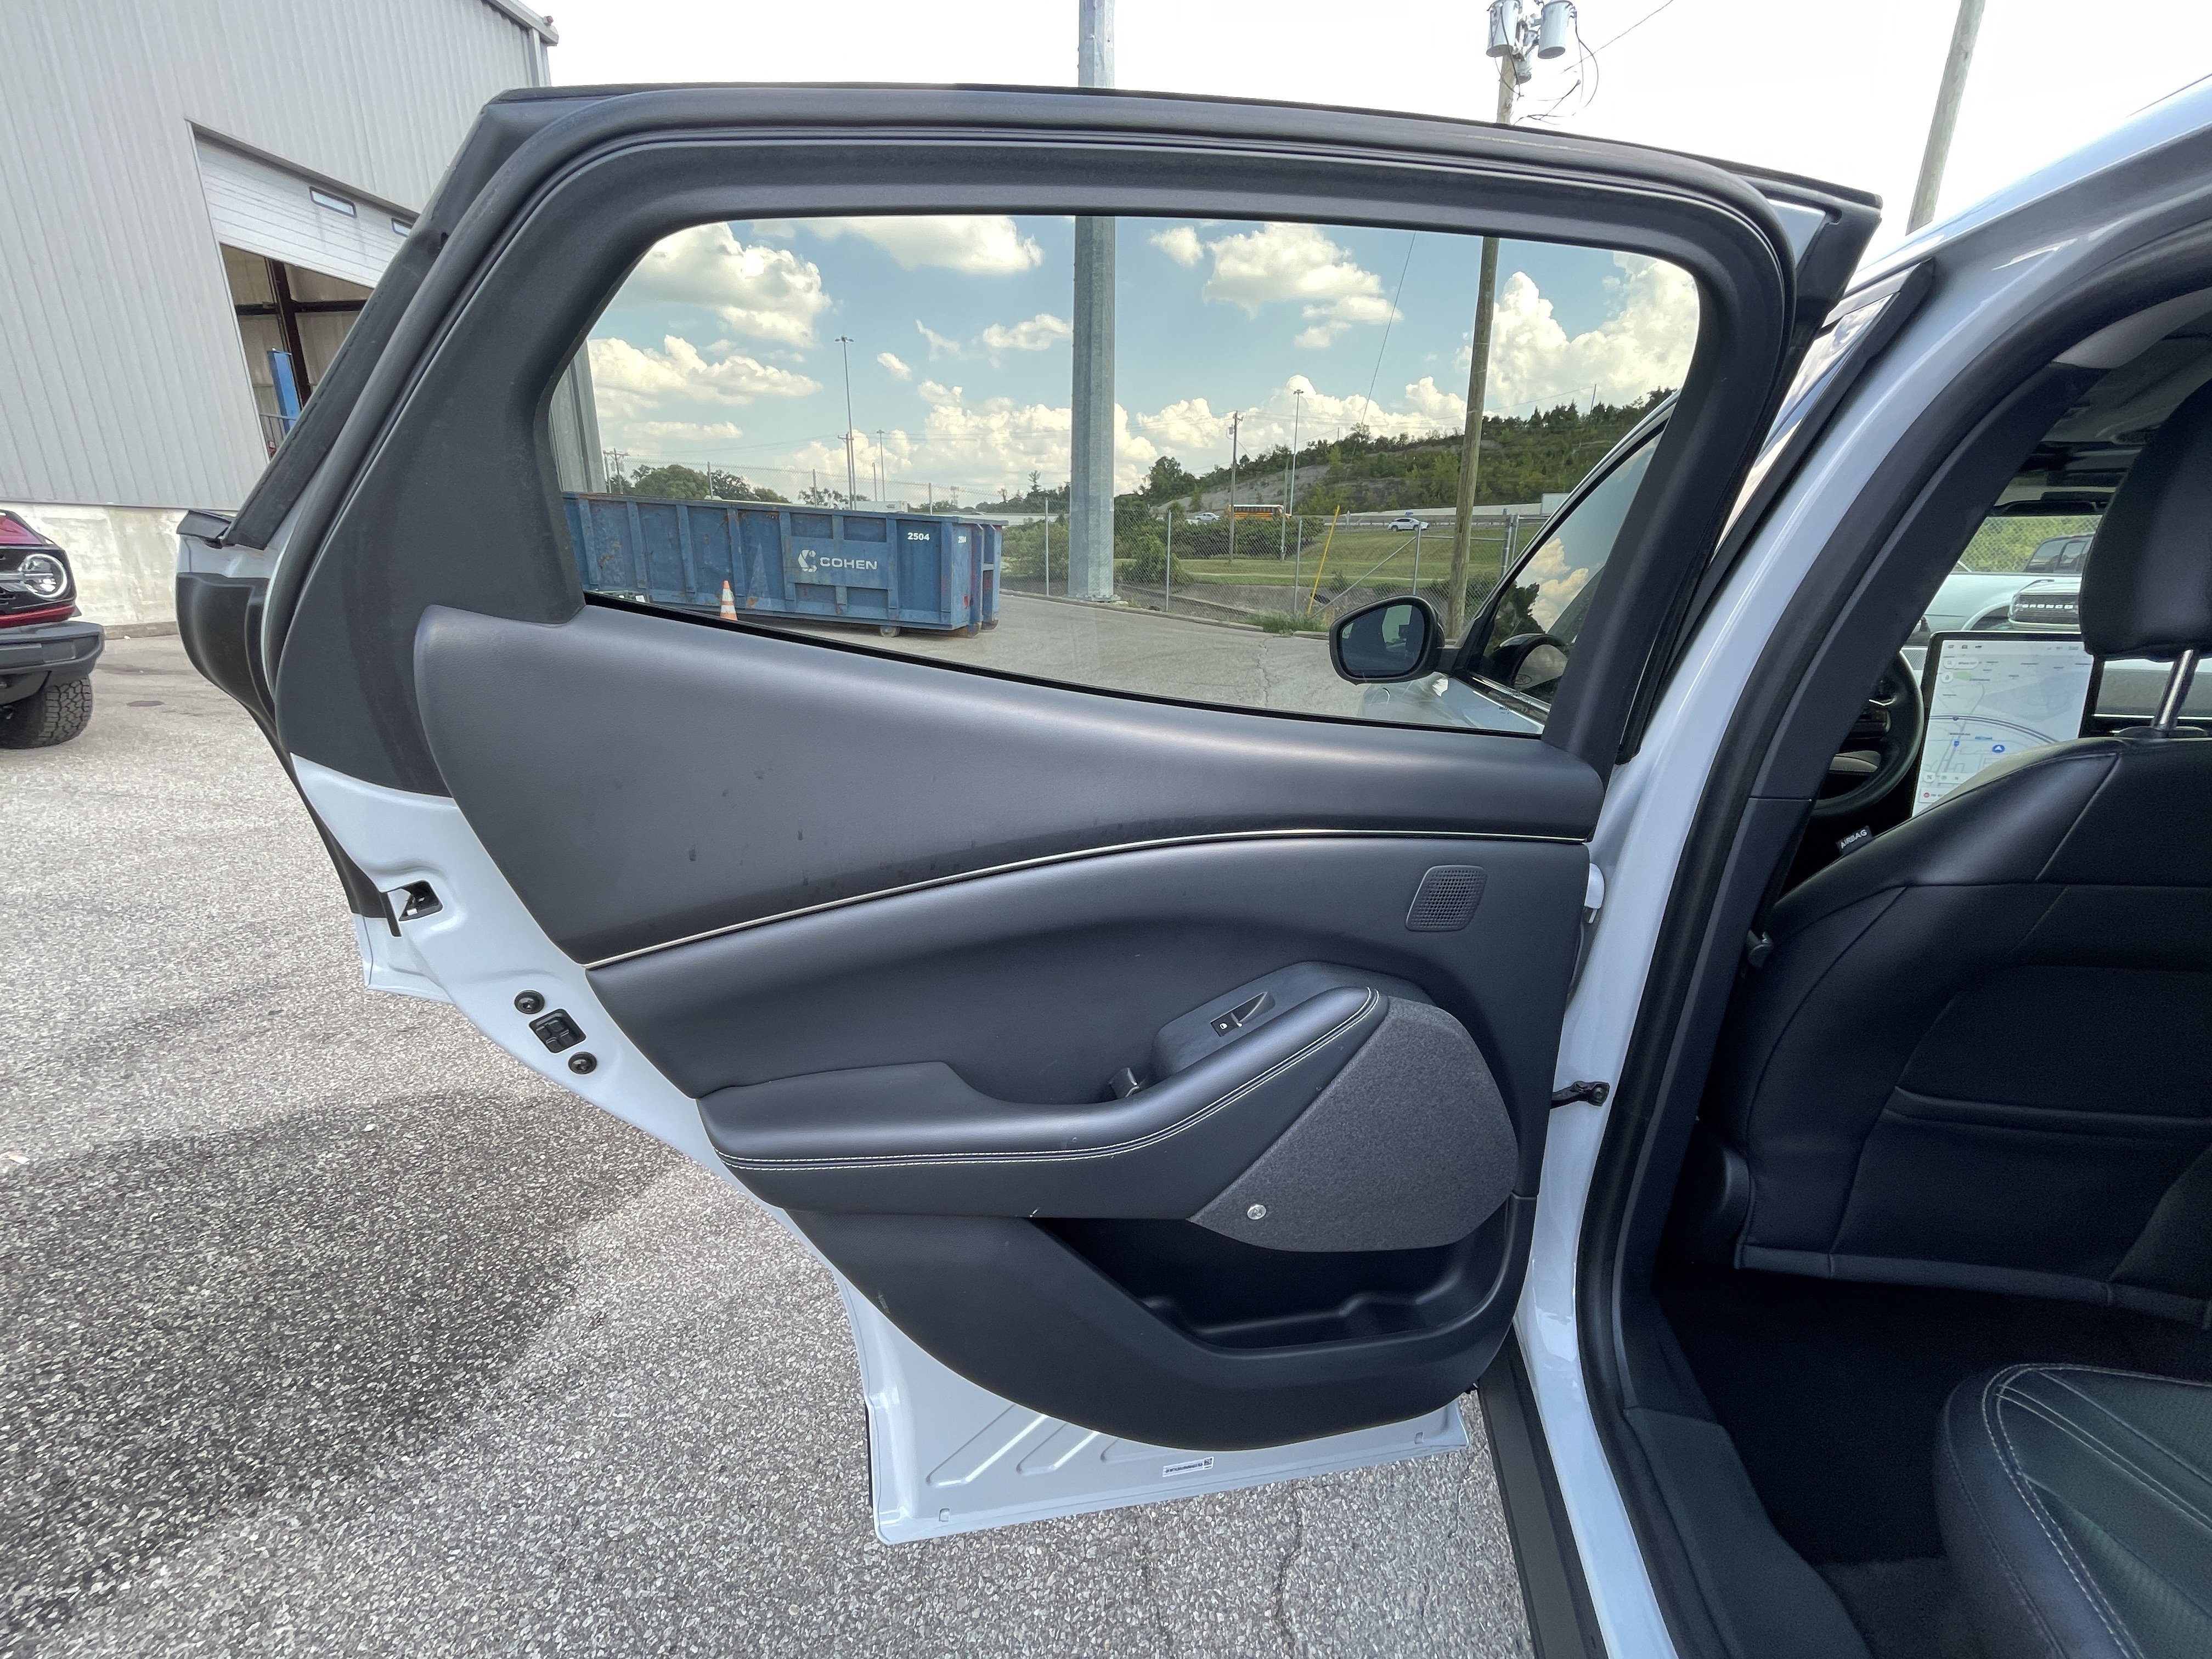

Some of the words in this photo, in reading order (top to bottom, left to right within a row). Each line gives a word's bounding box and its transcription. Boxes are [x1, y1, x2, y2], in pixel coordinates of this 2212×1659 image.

[907, 532, 930, 541] 2504
[820, 557, 878, 570] COHEN
[1841, 829, 1867, 849] AIRBAG
